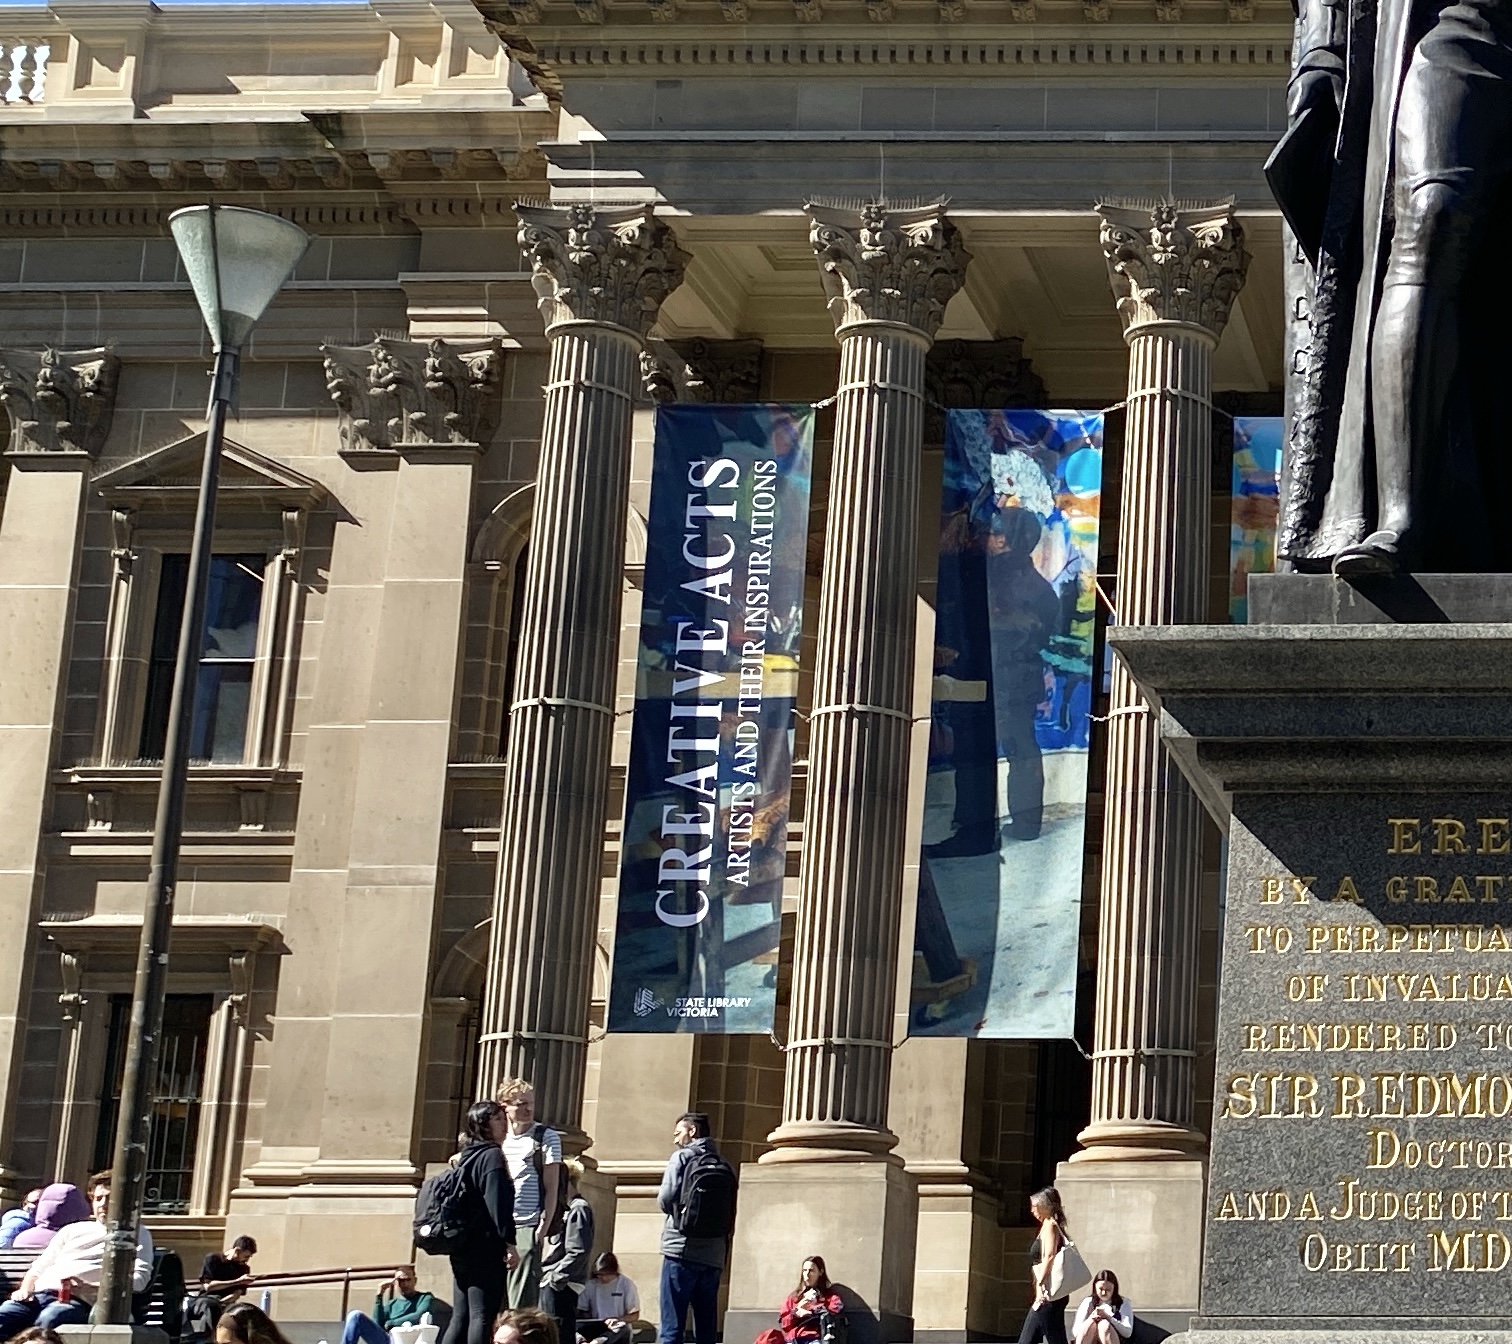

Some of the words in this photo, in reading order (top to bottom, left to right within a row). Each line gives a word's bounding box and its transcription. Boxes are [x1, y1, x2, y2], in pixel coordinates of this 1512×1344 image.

[680, 458, 740, 605] ACTS
[744, 459, 777, 633] INSPIRATIONS
[738, 639, 766, 717] THEIR
[733, 720, 760, 777] AND
[655, 619, 729, 928] CREATIVE
[726, 781, 755, 887] ARTISTS
[1260, 876, 1310, 905] BY
[1334, 876, 1364, 904] A
[1244, 926, 1294, 953] TO
[675, 997, 705, 1007] STATE
[707, 998, 751, 1008] LIBRARY
[1287, 974, 1331, 1002] OF
[666, 1007, 719, 1017] VICTORIA
[1241, 1024, 1457, 1052] RENDERED
[1222, 1074, 1323, 1119] SIR
[1214, 1191, 1291, 1222] AND
[1291, 1192, 1321, 1221] A
[1329, 1178, 1444, 1222] JUDGE
[1450, 1191, 1489, 1221] OF
[1300, 1232, 1416, 1272] OBIIT
